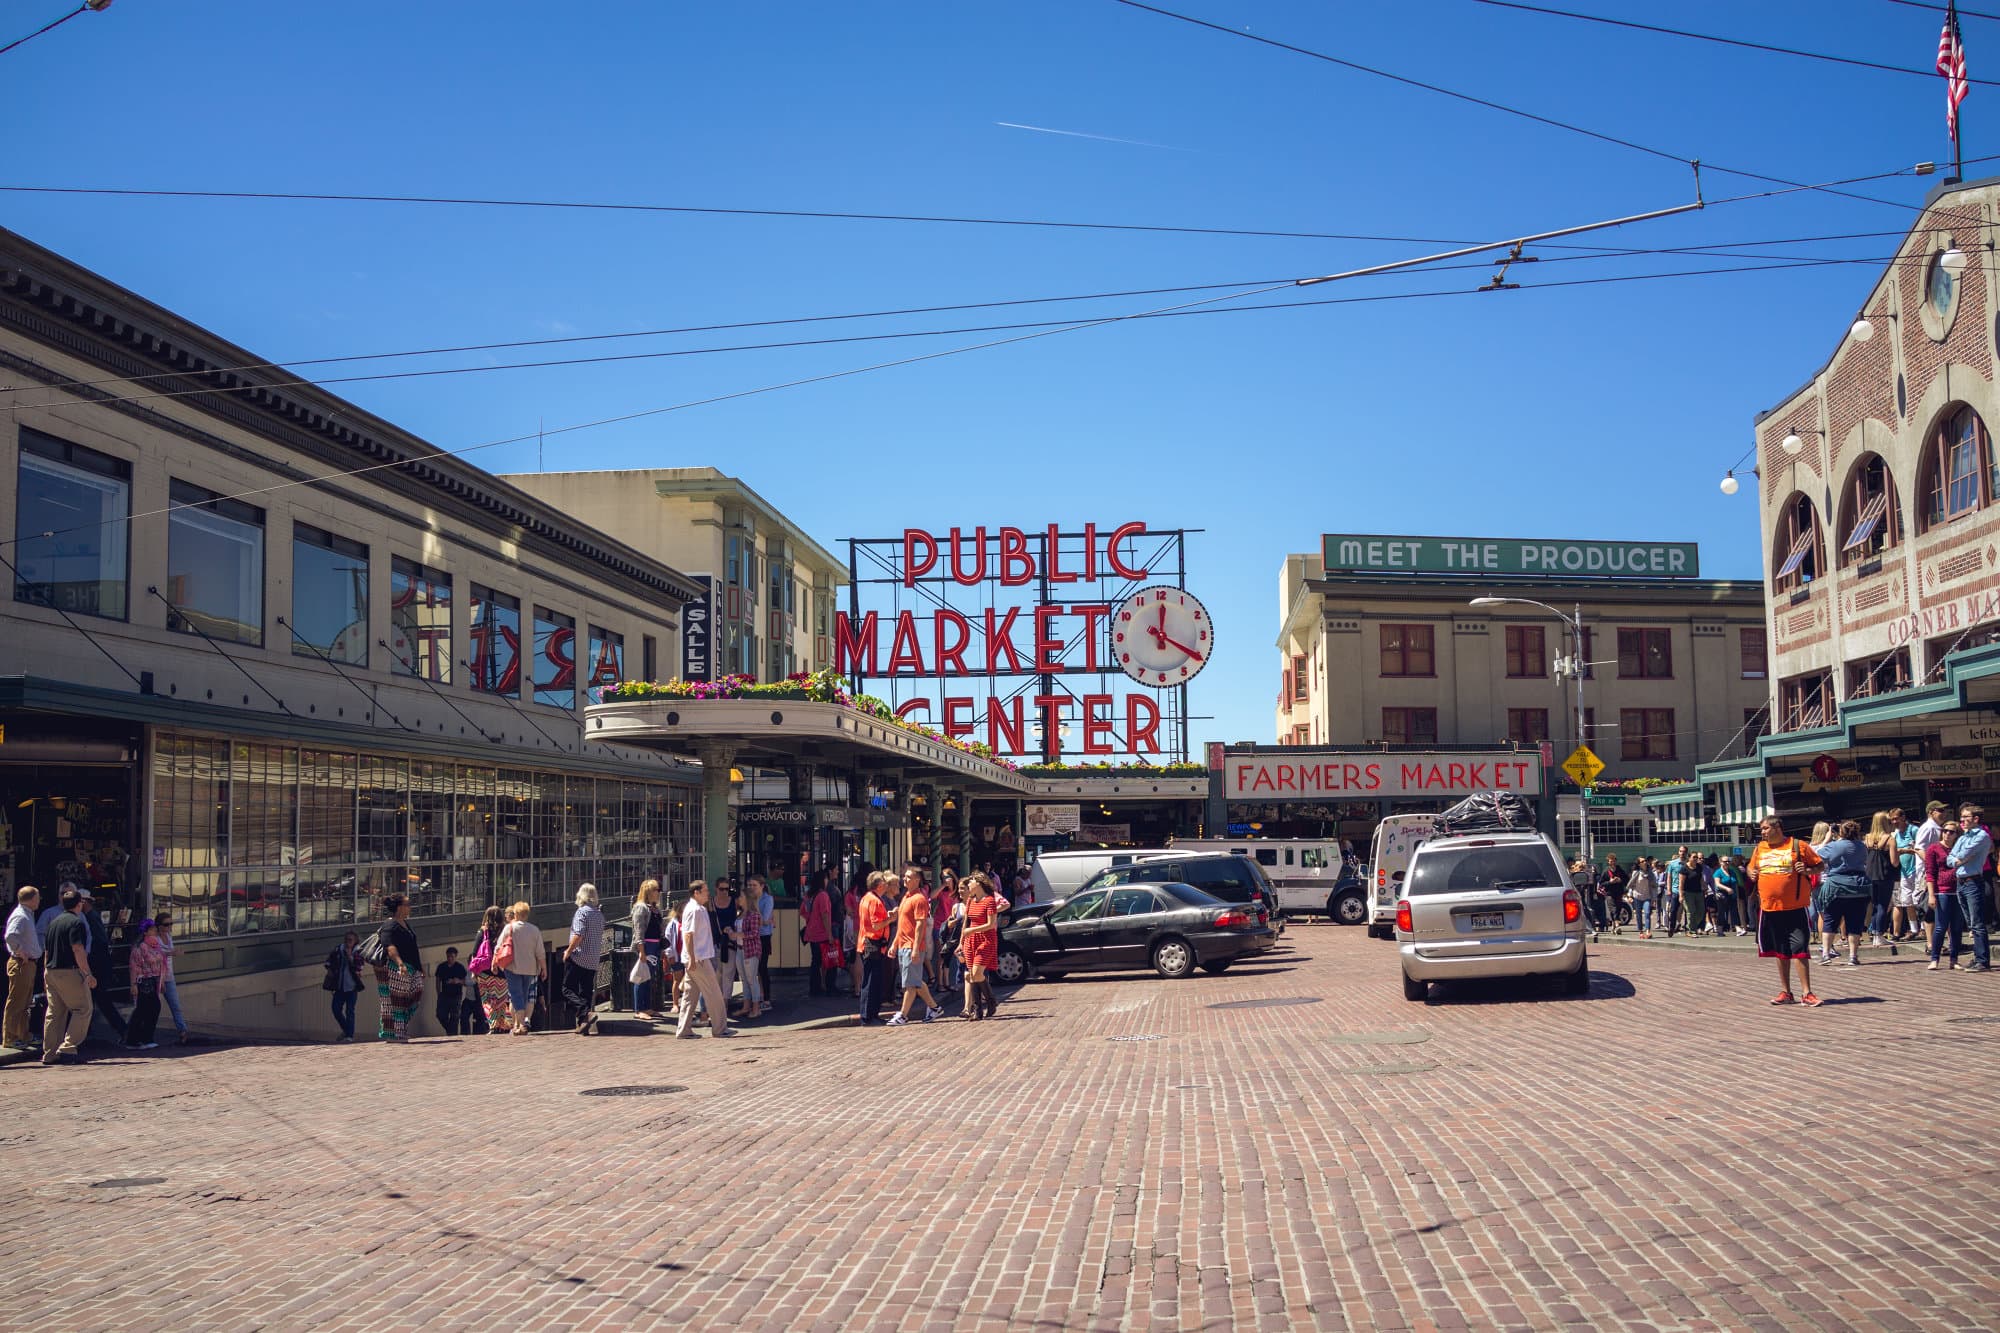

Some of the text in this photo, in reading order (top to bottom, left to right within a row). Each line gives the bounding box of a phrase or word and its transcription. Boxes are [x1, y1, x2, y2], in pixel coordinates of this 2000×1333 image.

[904, 521, 1148, 588] PUBLIC
[1340, 541, 1686, 572] MEET THE PRODUCER
[1156, 591, 1167, 600] 12
[1180, 596, 1184, 605] 1
[1136, 597, 1144, 606] 11
[1121, 612, 1131, 621] 10
[1194, 611, 1201, 620] 2
[1888, 602, 1960, 646] CORNER
[1117, 632, 1124, 642] 9
[1200, 631, 1207, 640] 3
[686, 609, 706, 674] SALLE
[835, 605, 1110, 678] MARKET
[1122, 653, 1129, 663] 8
[1138, 668, 1146, 677] 7
[1181, 666, 1188, 676] 5
[1158, 673, 1166, 682] 6
[1904, 760, 1982, 774] The Crumpet Shop
[1238, 762, 1529, 791] FARMERS MARKET
[1591, 797, 1606, 805] Pike
